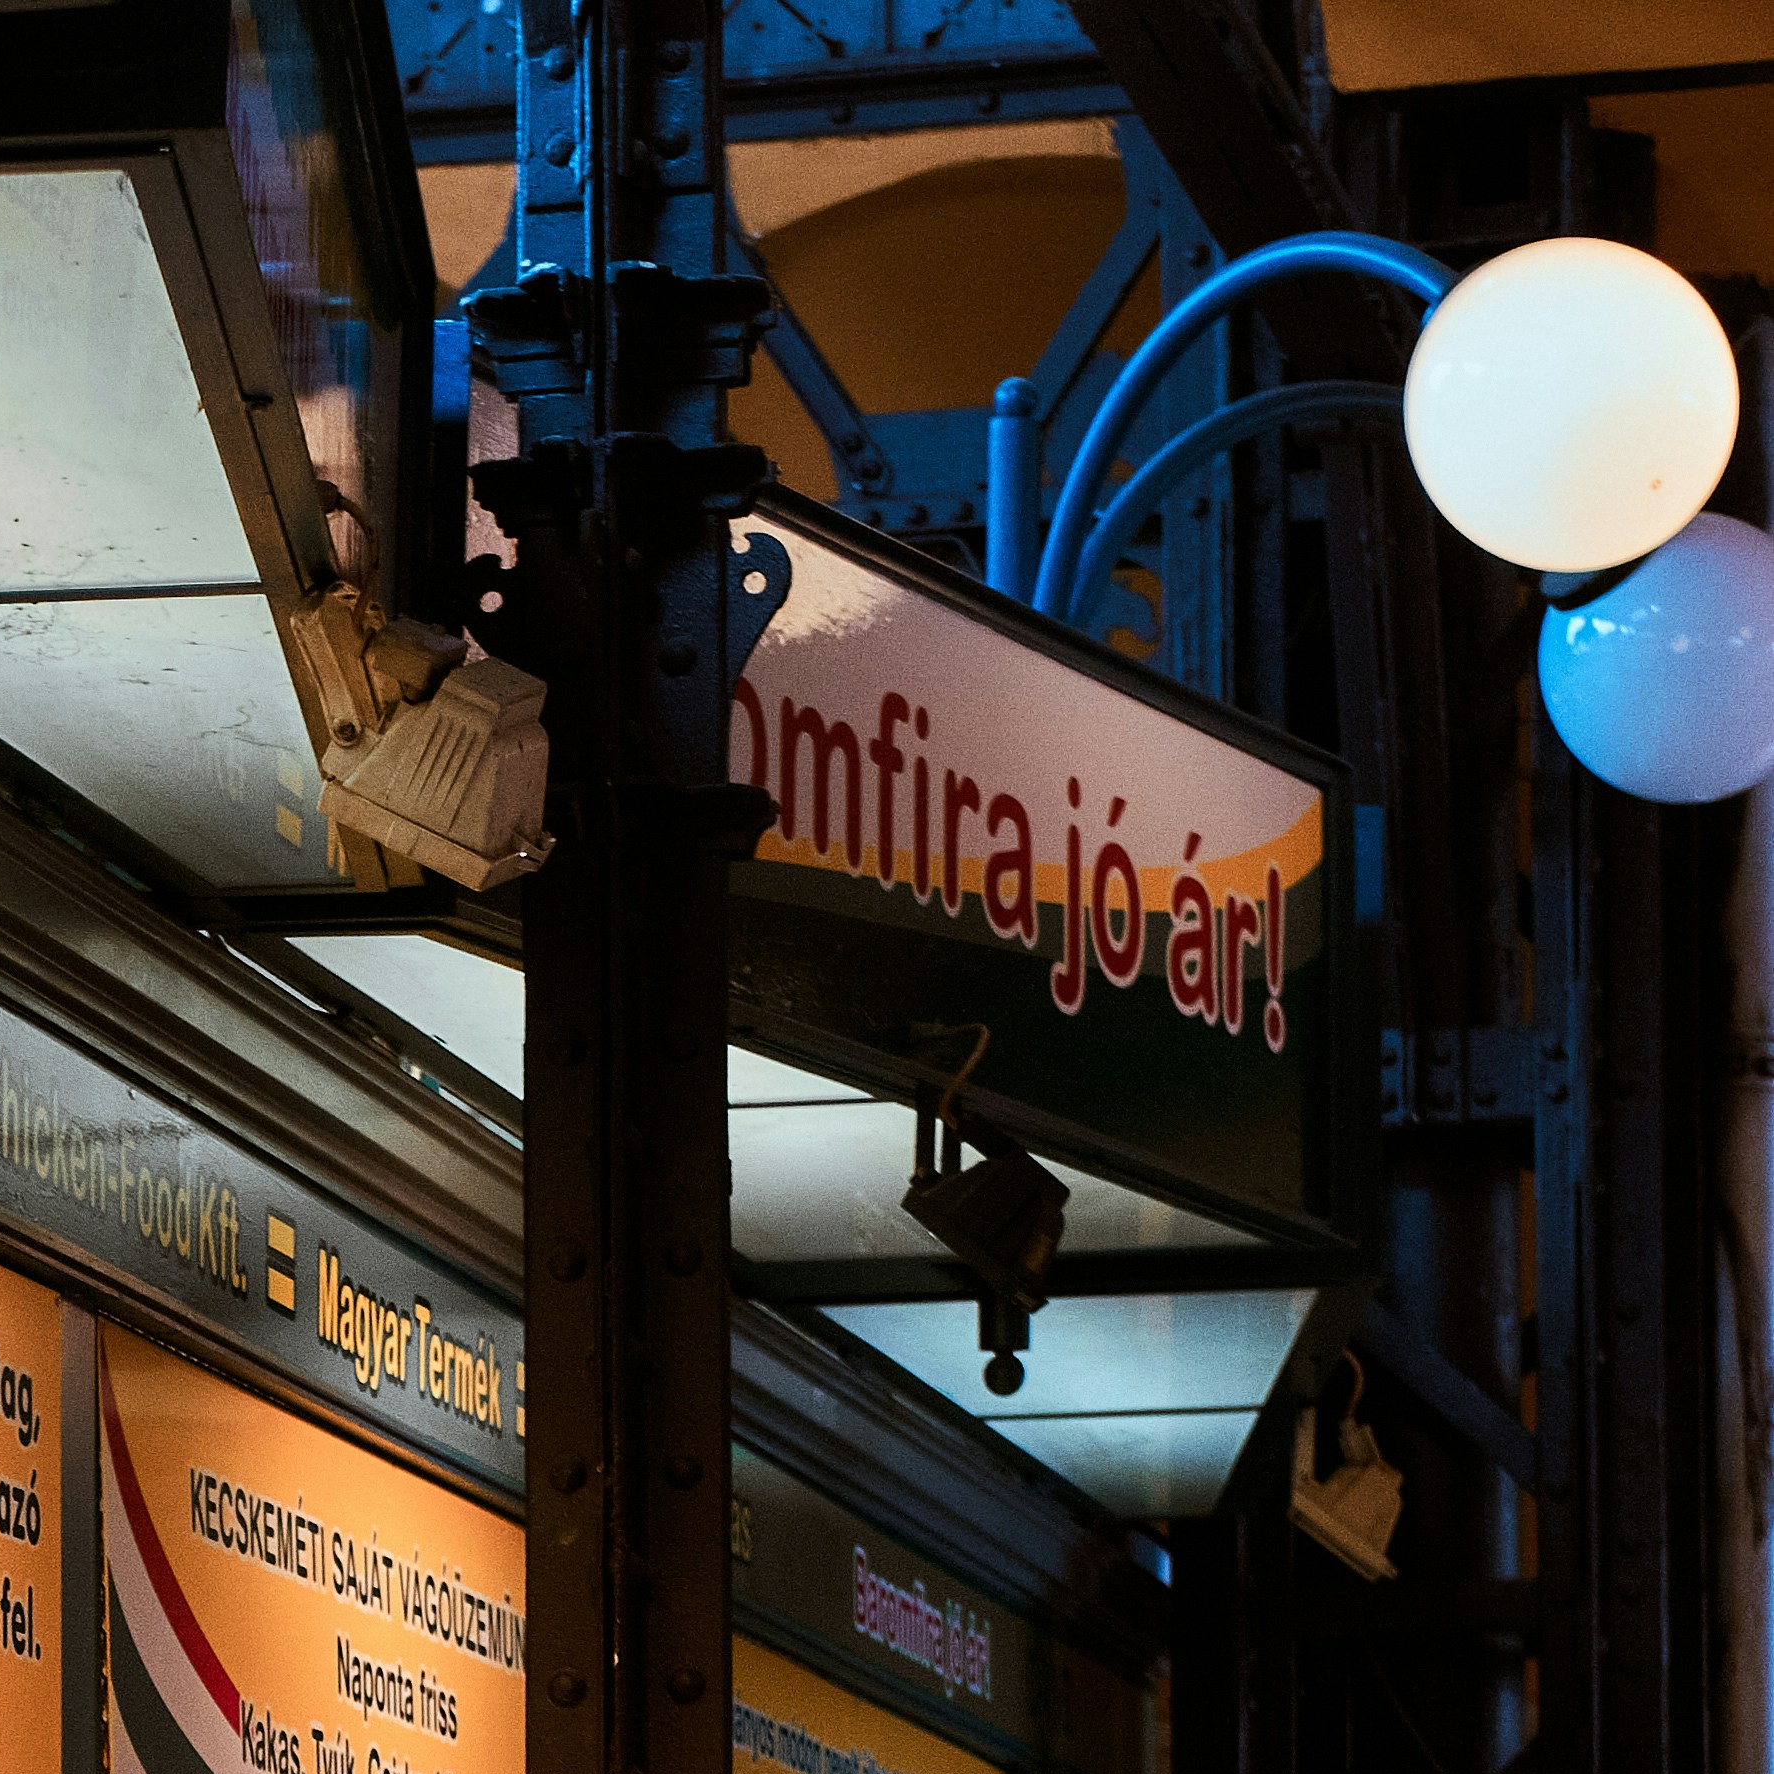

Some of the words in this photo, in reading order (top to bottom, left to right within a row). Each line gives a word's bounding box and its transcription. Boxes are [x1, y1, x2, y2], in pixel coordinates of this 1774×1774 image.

[1049, 776, 1145, 1016] jó
[1167, 832, 1286, 1053] ár!
[199, 1176, 247, 1293] Kft.
[317, 1247, 411, 1391] Magyar
[414, 1303, 502, 1430] Termék
[189, 1467, 326, 1587] KECSKEMÉTI
[332, 1530, 394, 1616] SAJÁT
[0, 1576, 41, 1660] fel.
[337, 1634, 414, 1725] Naponta
[421, 1676, 458, 1738] friss
